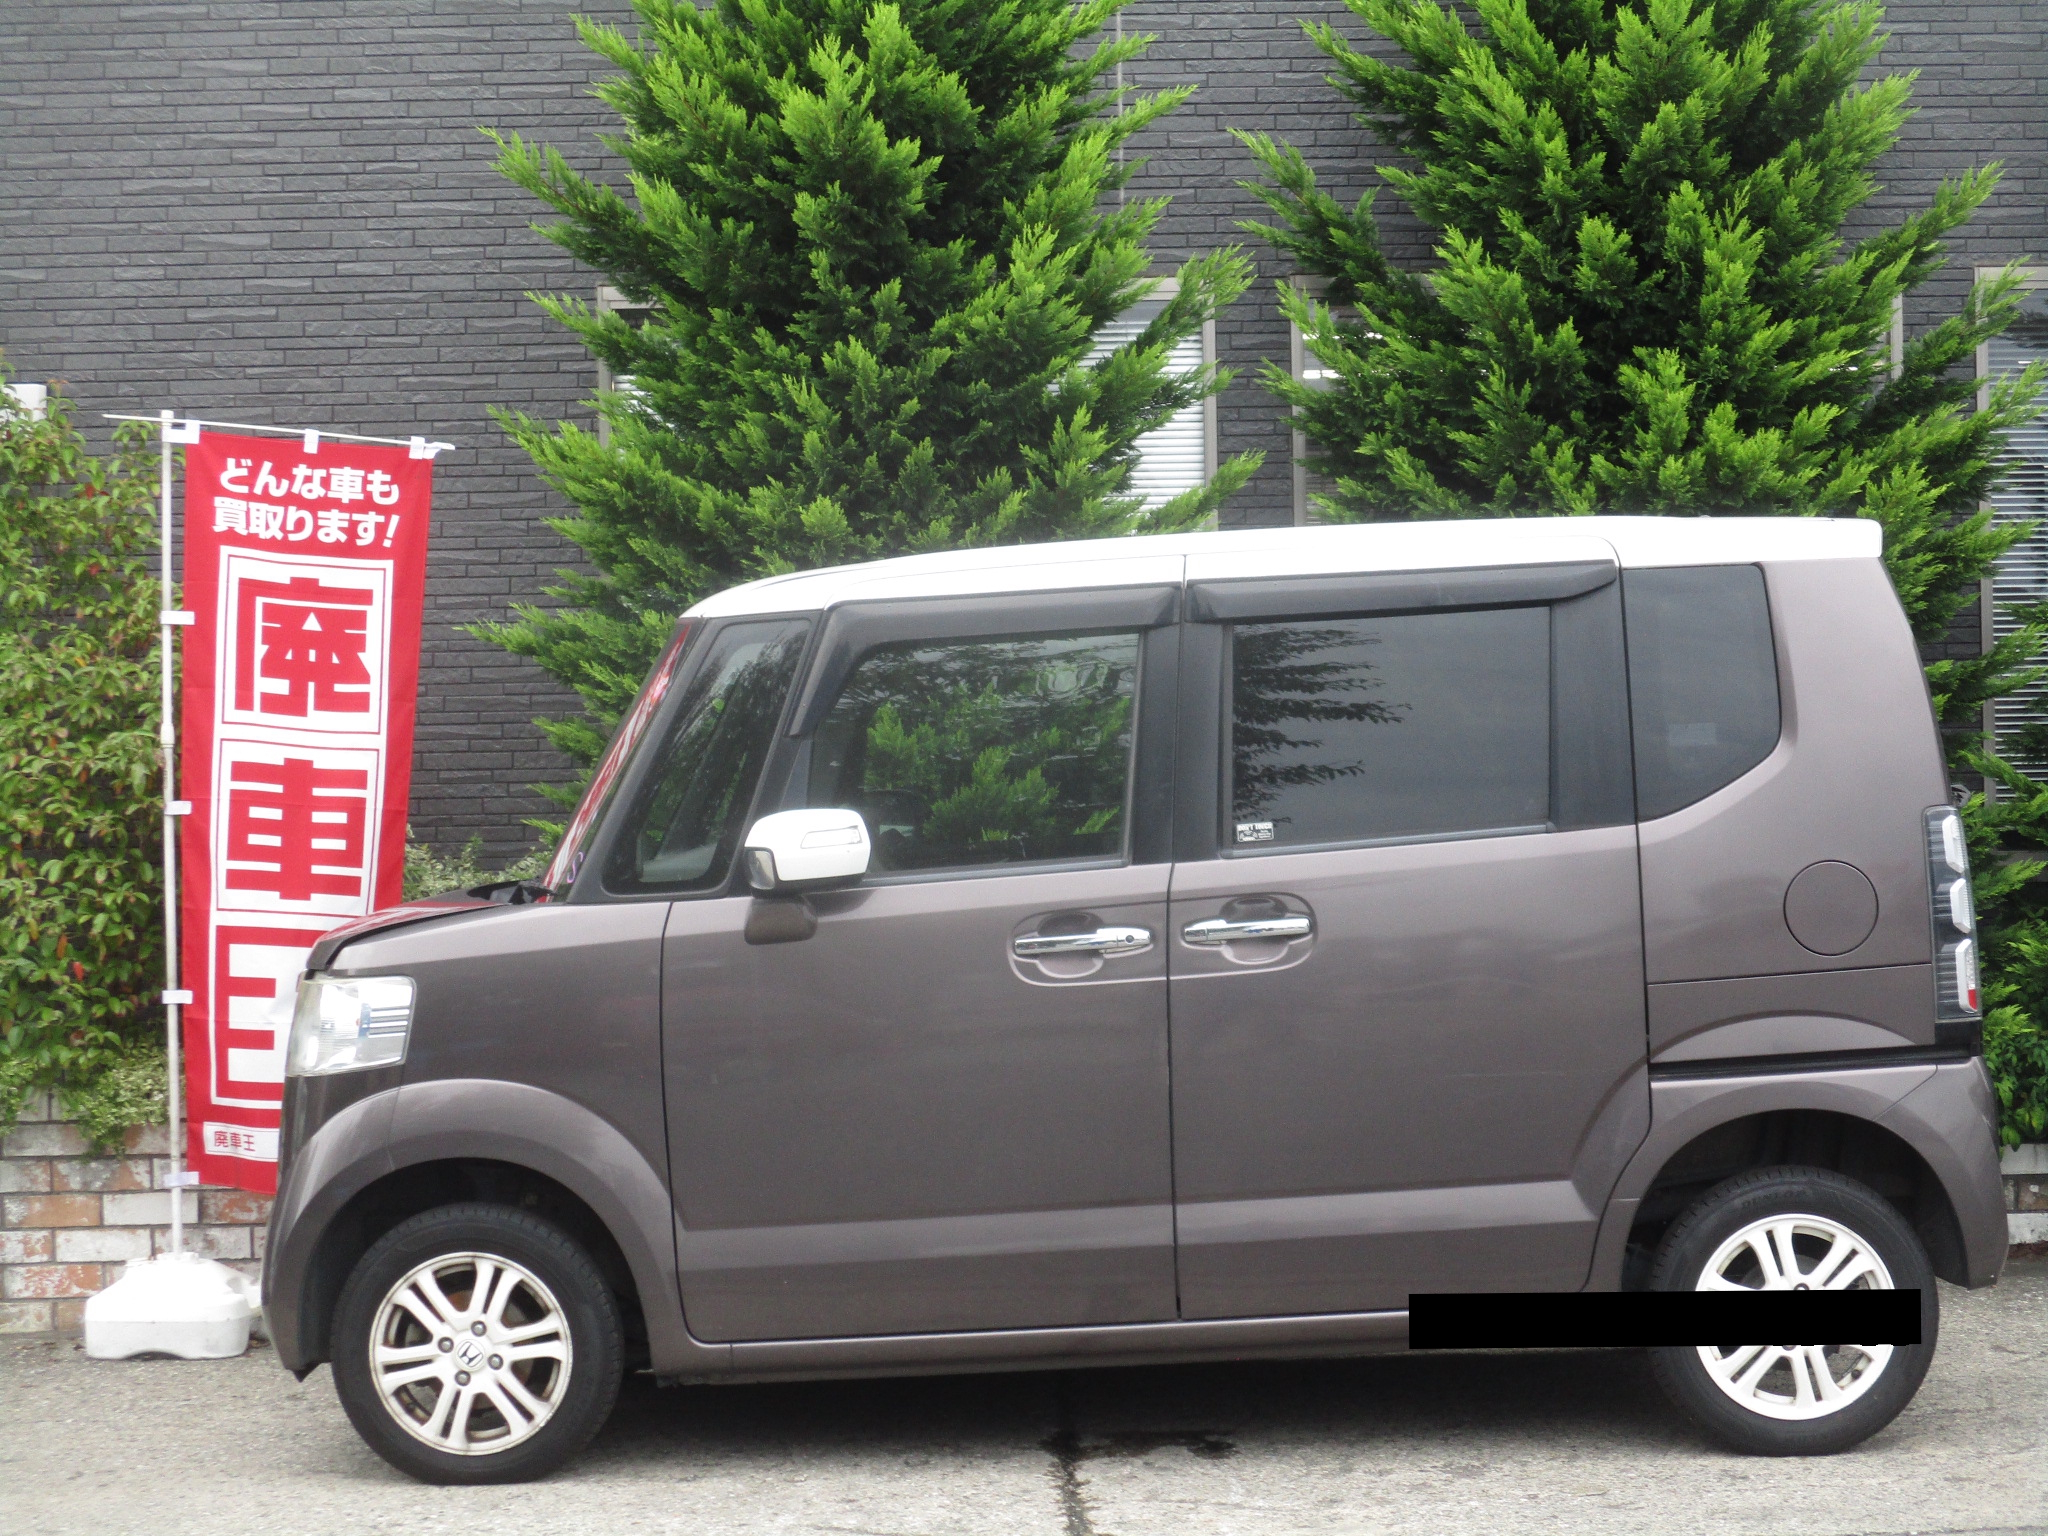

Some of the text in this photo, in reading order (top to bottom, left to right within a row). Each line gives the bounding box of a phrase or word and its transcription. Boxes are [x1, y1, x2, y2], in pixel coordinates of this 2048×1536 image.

[219, 457, 400, 505] どんな車も
[212, 497, 401, 548] 買取ります!
[214, 1130, 256, 1152] 廃車王
